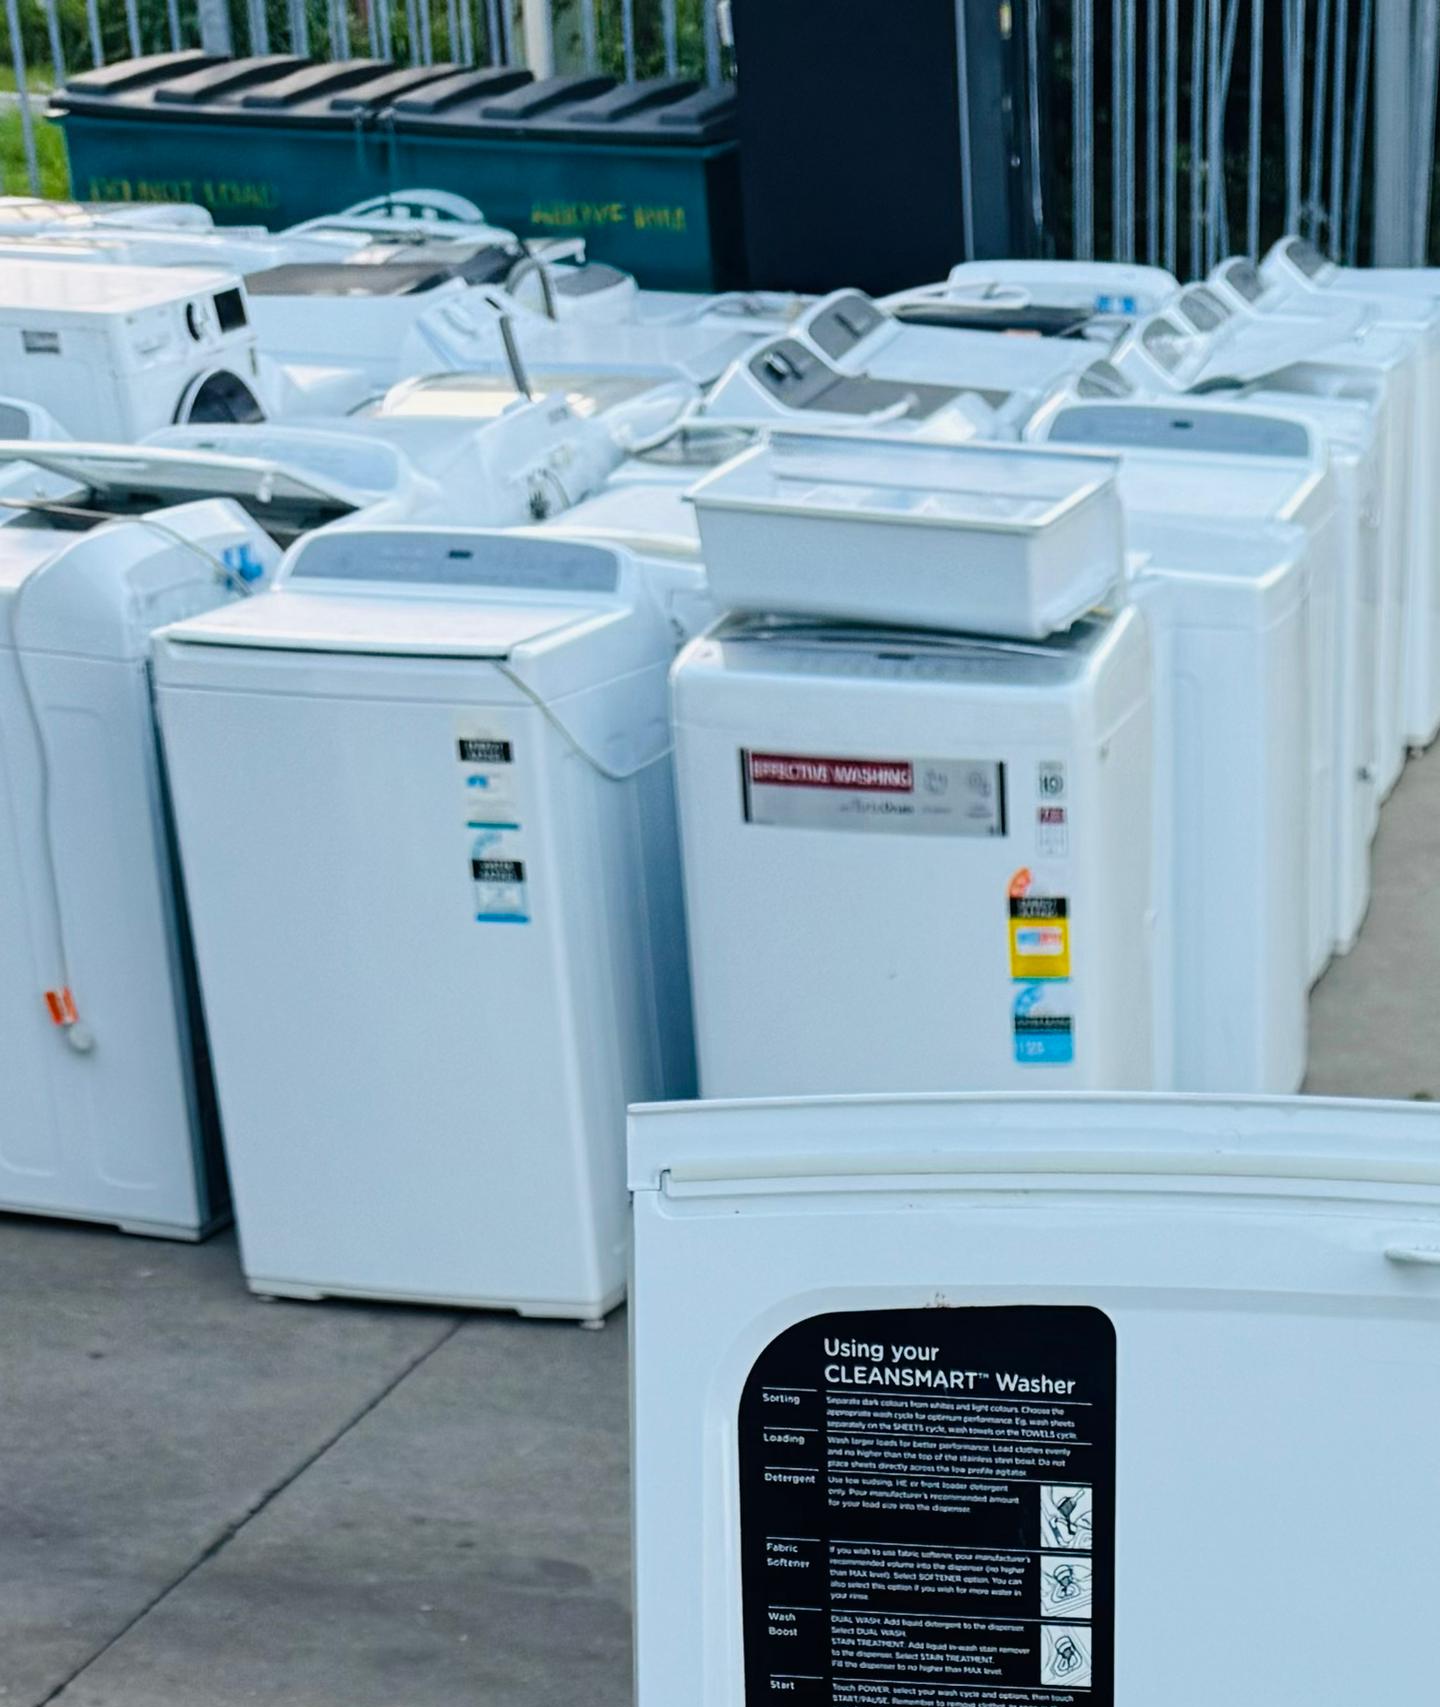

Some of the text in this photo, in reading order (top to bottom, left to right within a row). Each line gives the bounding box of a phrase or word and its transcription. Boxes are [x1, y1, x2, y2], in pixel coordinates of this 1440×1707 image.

[754, 760, 912, 787] EFFECTIVE WASHING
[824, 1338, 939, 1364] Using your
[995, 1372, 1075, 1394] Washer
[762, 1393, 799, 1404] Sorting
[763, 1433, 804, 1444] Loading
[764, 1472, 814, 1484] Detergent
[766, 1542, 797, 1552] Fabric
[767, 1557, 809, 1567] Softener
[768, 1612, 795, 1621] Wash
[768, 1626, 796, 1636] Boost
[770, 1680, 794, 1689] Start
